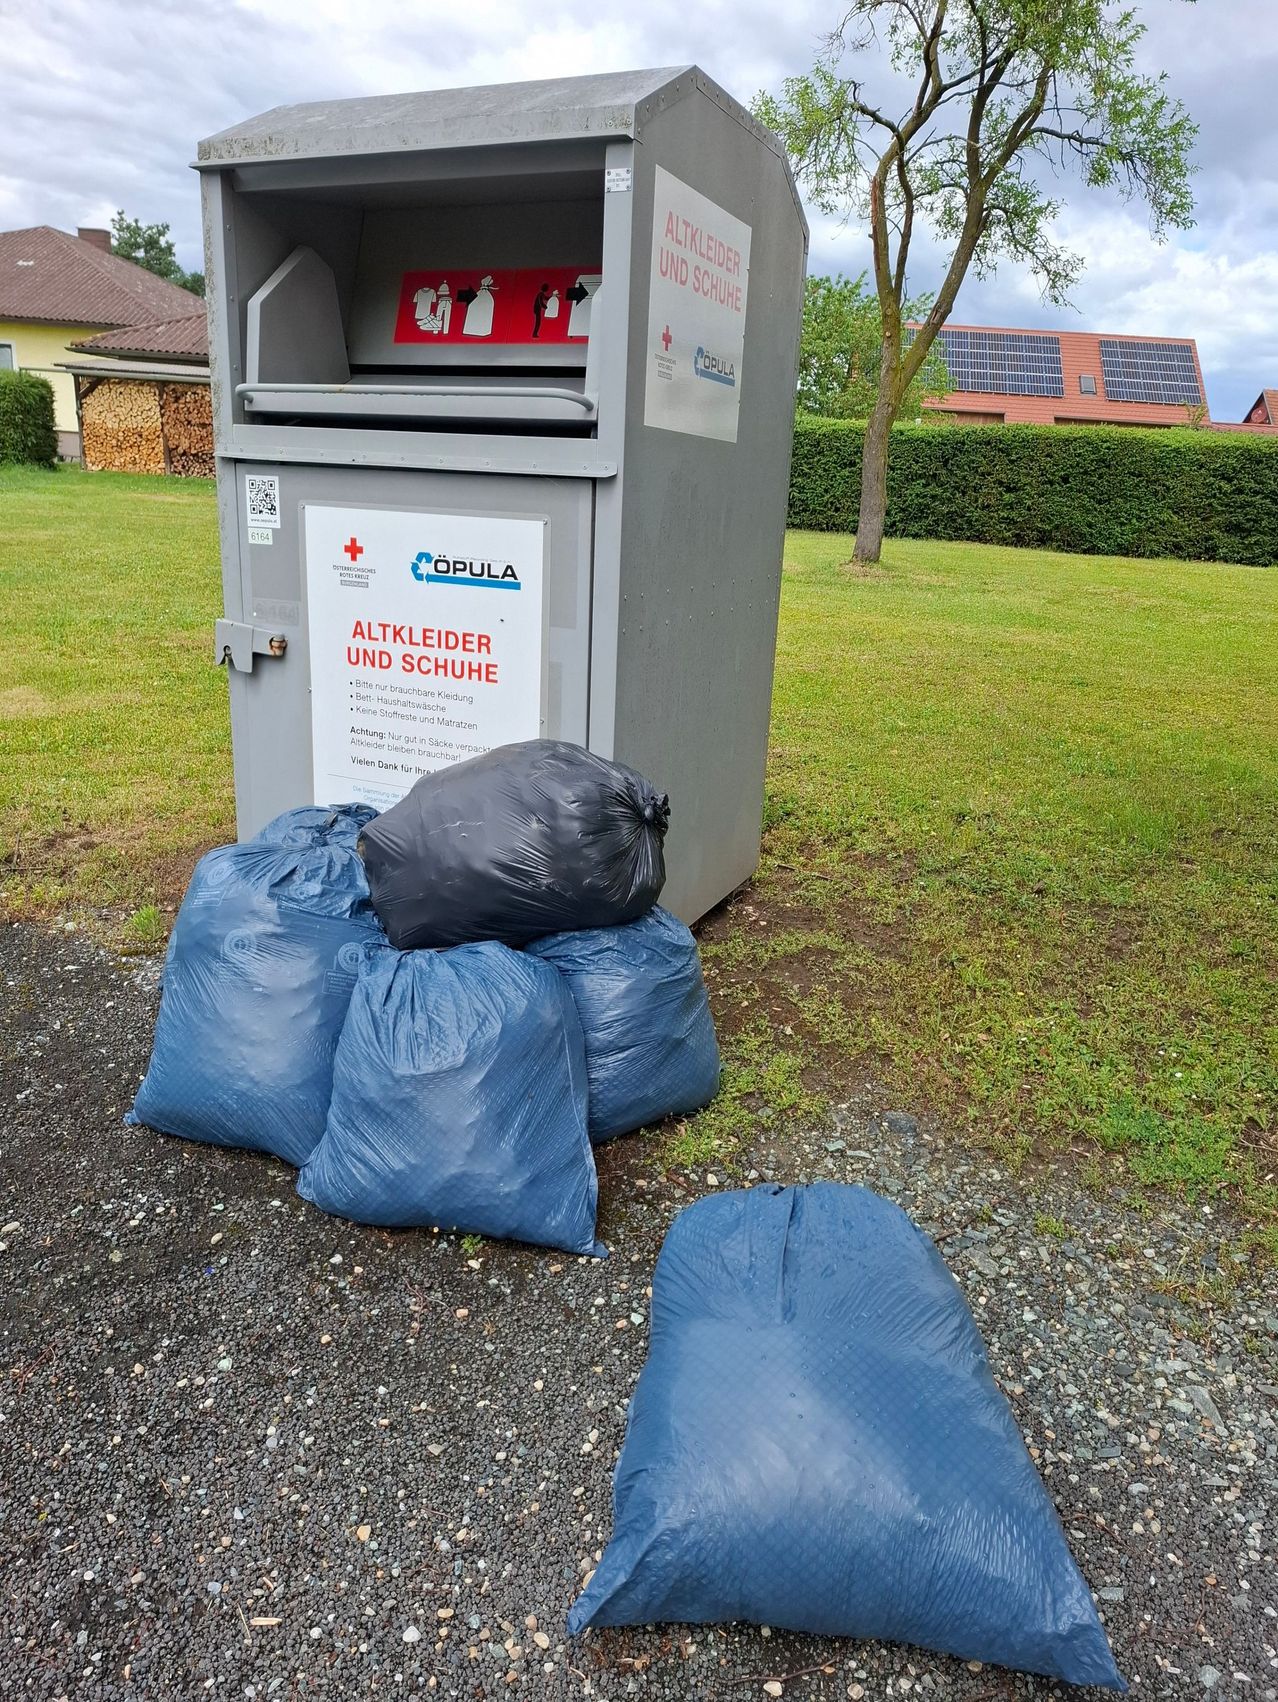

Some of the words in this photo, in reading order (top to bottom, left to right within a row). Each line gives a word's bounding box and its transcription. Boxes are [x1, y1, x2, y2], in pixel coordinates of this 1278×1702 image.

[665, 210, 741, 277] ALTKLEIDER
[660, 246, 689, 286] UND
[693, 265, 742, 312] SCHUHE
[703, 351, 735, 378] ÖPULA
[251, 532, 270, 541] 6164
[433, 554, 519, 580] ÖPULA
[351, 620, 492, 655] ALTKLEIDER
[347, 646, 393, 670] UND
[401, 653, 498, 684] SCHUHE
[355, 680, 374, 690] Bitte
[375, 683, 388, 692] nur
[390, 685, 436, 698] brauchbare
[437, 690, 474, 705] Kleidung
[355, 692, 375, 702] Bett-
[377, 696, 447, 713] Haushaltswäsche
[355, 706, 378, 716] Keine
[379, 708, 417, 722] Stoffreste
[419, 715, 435, 725] und
[437, 717, 478, 731] Matratzen
[350, 726, 386, 740] Achtung:
[388, 732, 402, 741] Nur
[404, 735, 417, 745] gut
[420, 737, 427, 745] in
[428, 737, 454, 749] Säcke
[350, 738, 386, 751] Altkleider
[388, 743, 416, 756] bleiben
[418, 747, 461, 762] brauchbar!
[350, 755, 376, 768] Vielen
[378, 760, 399, 772] Dank
[401, 764, 413, 773] für
[415, 767, 431, 776] Ihre
